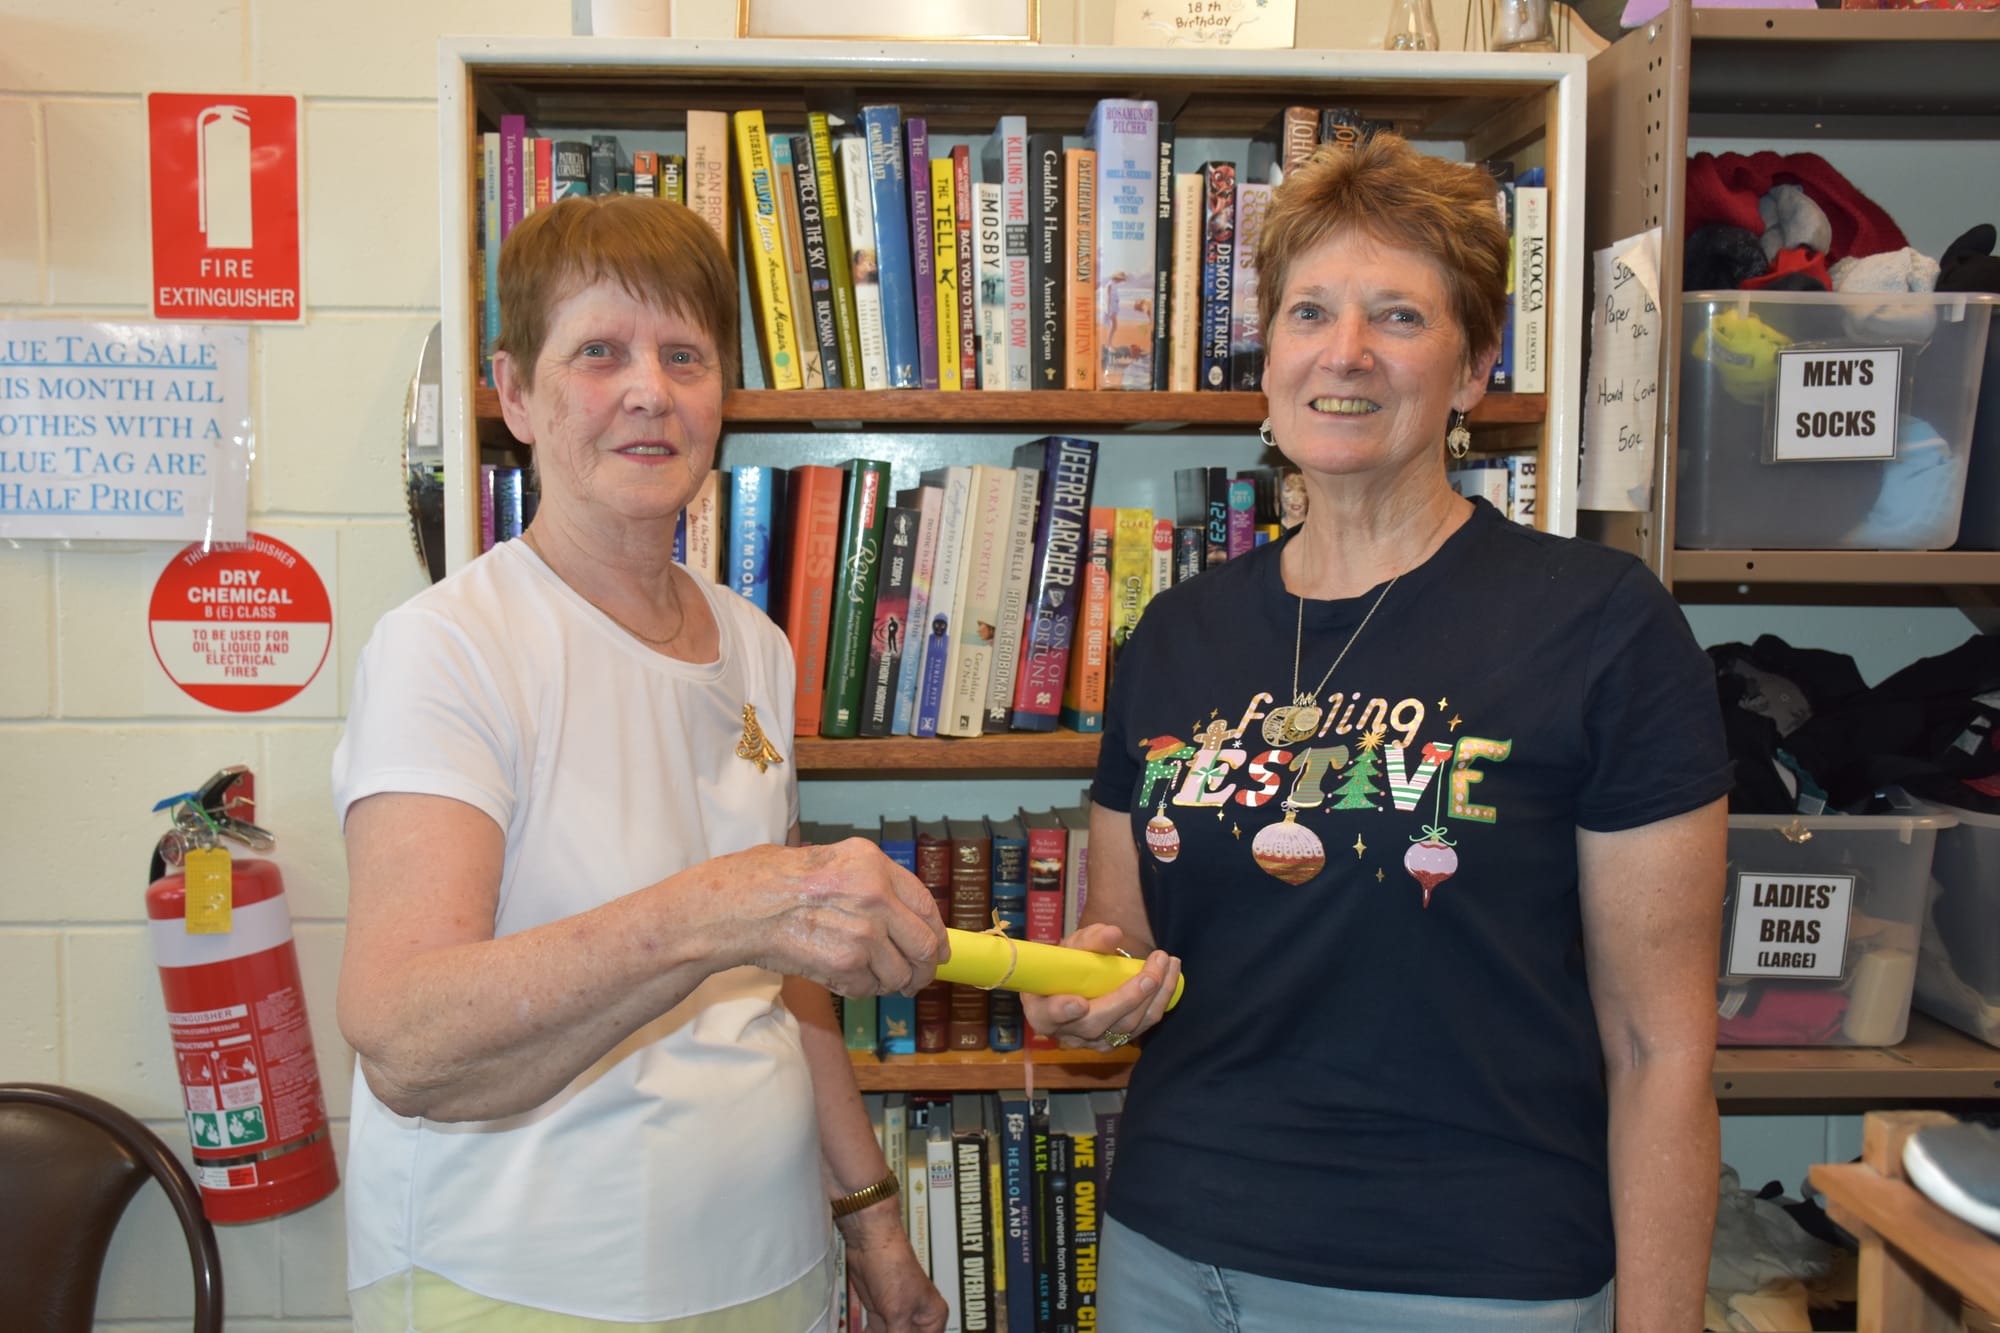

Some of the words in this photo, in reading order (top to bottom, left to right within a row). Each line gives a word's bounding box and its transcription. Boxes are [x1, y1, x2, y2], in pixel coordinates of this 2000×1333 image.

[1176, 15, 1232, 29] Birthday
[1188, 3, 1202, 13] 18
[1208, 2, 1222, 12] th
[812, 116, 827, 135] THE
[1112, 121, 1147, 135] PILCHER
[1290, 116, 1318, 165] JOHN
[505, 135, 516, 165] Taking
[558, 151, 585, 165] PATRICIA
[748, 124, 762, 169] MICHAEL
[815, 136, 831, 157] WIT
[912, 136, 925, 158] THE
[1007, 137, 1023, 185] KILLING
[1161, 142, 1172, 157] An
[507, 167, 515, 188] Care
[557, 164, 586, 178] CORNWELL
[707, 161, 722, 193] DAN
[817, 158, 833, 173] OF
[1159, 157, 1171, 203] Awkward
[507, 190, 516, 201] of
[752, 169, 773, 215] TULLIVER
[799, 173, 817, 203] PIECE
[819, 174, 838, 218] WALKER
[938, 178, 949, 200] THE
[1043, 150, 1058, 214] Gaddafi's
[1077, 157, 1092, 226] CATHERINE
[803, 206, 819, 223] OF
[914, 190, 928, 217] LOVE
[1009, 189, 1024, 221] TIME
[1159, 204, 1170, 219] Fit
[805, 225, 822, 245] THE
[937, 205, 953, 257] TELL
[959, 229, 971, 260] RACE
[982, 199, 1000, 270] MOSBY
[1044, 216, 1057, 265] Harem
[1240, 191, 1255, 270] COONTS
[808, 248, 826, 270] SKY
[916, 217, 929, 276] LANGUAGES
[1077, 228, 1091, 284] COOKSON
[201, 259, 254, 278] FIRE
[961, 262, 971, 285] YOU
[1011, 261, 1025, 297] DAVID
[1214, 244, 1231, 301] DEMON
[1530, 236, 1544, 313] IACOCCA
[159, 287, 295, 307] EXTINGUISHER
[962, 286, 972, 306] TO
[1044, 277, 1055, 319] Annick
[774, 307, 788, 351] Maupin
[816, 301, 834, 347] BUCKMAN
[963, 308, 973, 331] THE
[1604, 295, 1630, 334] Paper
[1644, 295, 1657, 313] ba
[964, 332, 974, 357] TOP
[1012, 319, 1026, 348] DOW
[1042, 320, 1055, 361] Cojean
[1214, 306, 1229, 359] STRIKE
[0, 340, 48, 363] UE
[56, 336, 128, 363] TAG
[137, 338, 217, 367] SALE
[1803, 359, 1874, 387] MEN'S
[38, 377, 155, 400] MONTH
[164, 380, 224, 403] ALL
[1598, 376, 1624, 406] Hard
[105, 416, 193, 439] WITH
[203, 417, 222, 440] A
[1618, 425, 1643, 451] 50c
[1796, 411, 1876, 438] SOCKS
[65, 447, 137, 475] TAG
[145, 453, 207, 475] ARE
[1053, 441, 1092, 518] JEFFREY
[0, 483, 81, 512] HALF
[90, 483, 184, 512] PRICE
[987, 478, 1002, 526] TARA'S
[1019, 474, 1034, 527] KATHRYN
[1520, 462, 1537, 529] BIN
[1209, 501, 1227, 544] 12:23
[1010, 531, 1027, 582] BONELLA
[1045, 517, 1082, 587] ARCHER
[1093, 529, 1108, 555] MAN
[219, 570, 260, 586] DRY
[847, 538, 878, 605] Roses
[890, 556, 904, 587] SCORPIA
[976, 532, 998, 601] FORTUNE
[1090, 557, 1106, 602] BELONG
[187, 587, 293, 604] CHEMICAL
[1003, 589, 1020, 627] HOTEL
[1123, 576, 1141, 609] City
[205, 606, 213, 618] B
[217, 606, 234, 620] (E)
[237, 606, 276, 619] CLASS
[1089, 602, 1103, 627] MRS
[193, 629, 207, 641] TO
[212, 629, 225, 641] BE
[230, 630, 261, 641] USED
[266, 631, 289, 642] FOR
[221, 642, 261, 654] LIQUID
[265, 643, 289, 654] AND
[1030, 610, 1053, 688] FORTUNE
[1051, 615, 1069, 659] SONS
[1087, 629, 1101, 666] QUEEN
[206, 655, 276, 666] ELECTRICAL
[225, 667, 258, 678] FIRES
[878, 652, 891, 685] ANTHONY
[995, 630, 1015, 702] KEROBOKAN
[1047, 664, 1060, 687] OF
[960, 658, 973, 696] O'Neill
[968, 653, 984, 704] Geraldine
[873, 686, 888, 724] HOROWITZ
[930, 687, 938, 707] PITT
[1234, 692, 1425, 748] fling
[1753, 884, 1836, 909] LADIES'
[1759, 919, 1821, 944] BRAS
[1757, 952, 1816, 969] (LARGE)
[1035, 1134, 1047, 1173] ALEK
[1074, 1136, 1094, 1169] WE
[958, 1143, 982, 1203] ARTHUR
[1008, 1147, 1021, 1239] HELLOLAND
[1056, 1196, 1064, 1204] a
[1075, 1181, 1096, 1232] OWN
[961, 1204, 984, 1252] HAILEY
[1055, 1206, 1065, 1246] universe
[1057, 1247, 1066, 1271] from
[1076, 1244, 1096, 1294] THIS
[963, 1256, 987, 1331] OVERLOAD
[1040, 1273, 1049, 1298] ALEK
[1057, 1272, 1068, 1310] nothing
[1041, 1301, 1050, 1322] WEK
